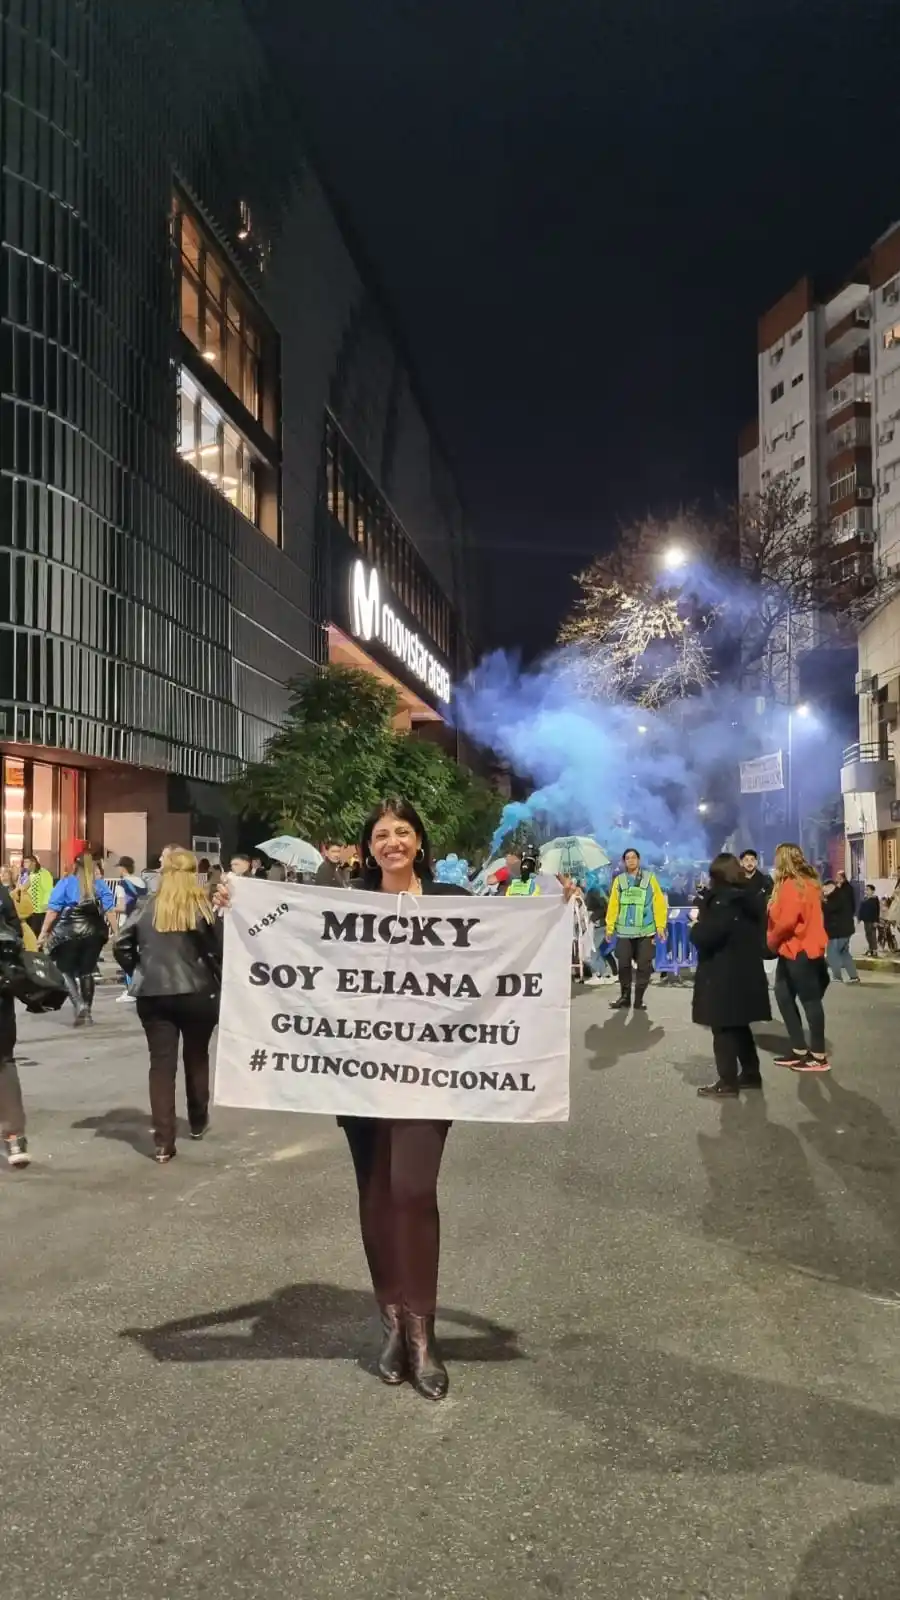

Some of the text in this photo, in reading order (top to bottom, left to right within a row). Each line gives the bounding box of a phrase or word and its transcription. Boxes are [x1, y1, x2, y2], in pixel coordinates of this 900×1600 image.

[382, 603, 428, 682] movistar
[320, 910, 480, 948] MICKY
[249, 961, 543, 998] SOY ELIANA DE
[271, 1013, 521, 1046] GUALEGUAYCHÚ
[249, 1048, 536, 1093] #TUINCONDICIONAL
